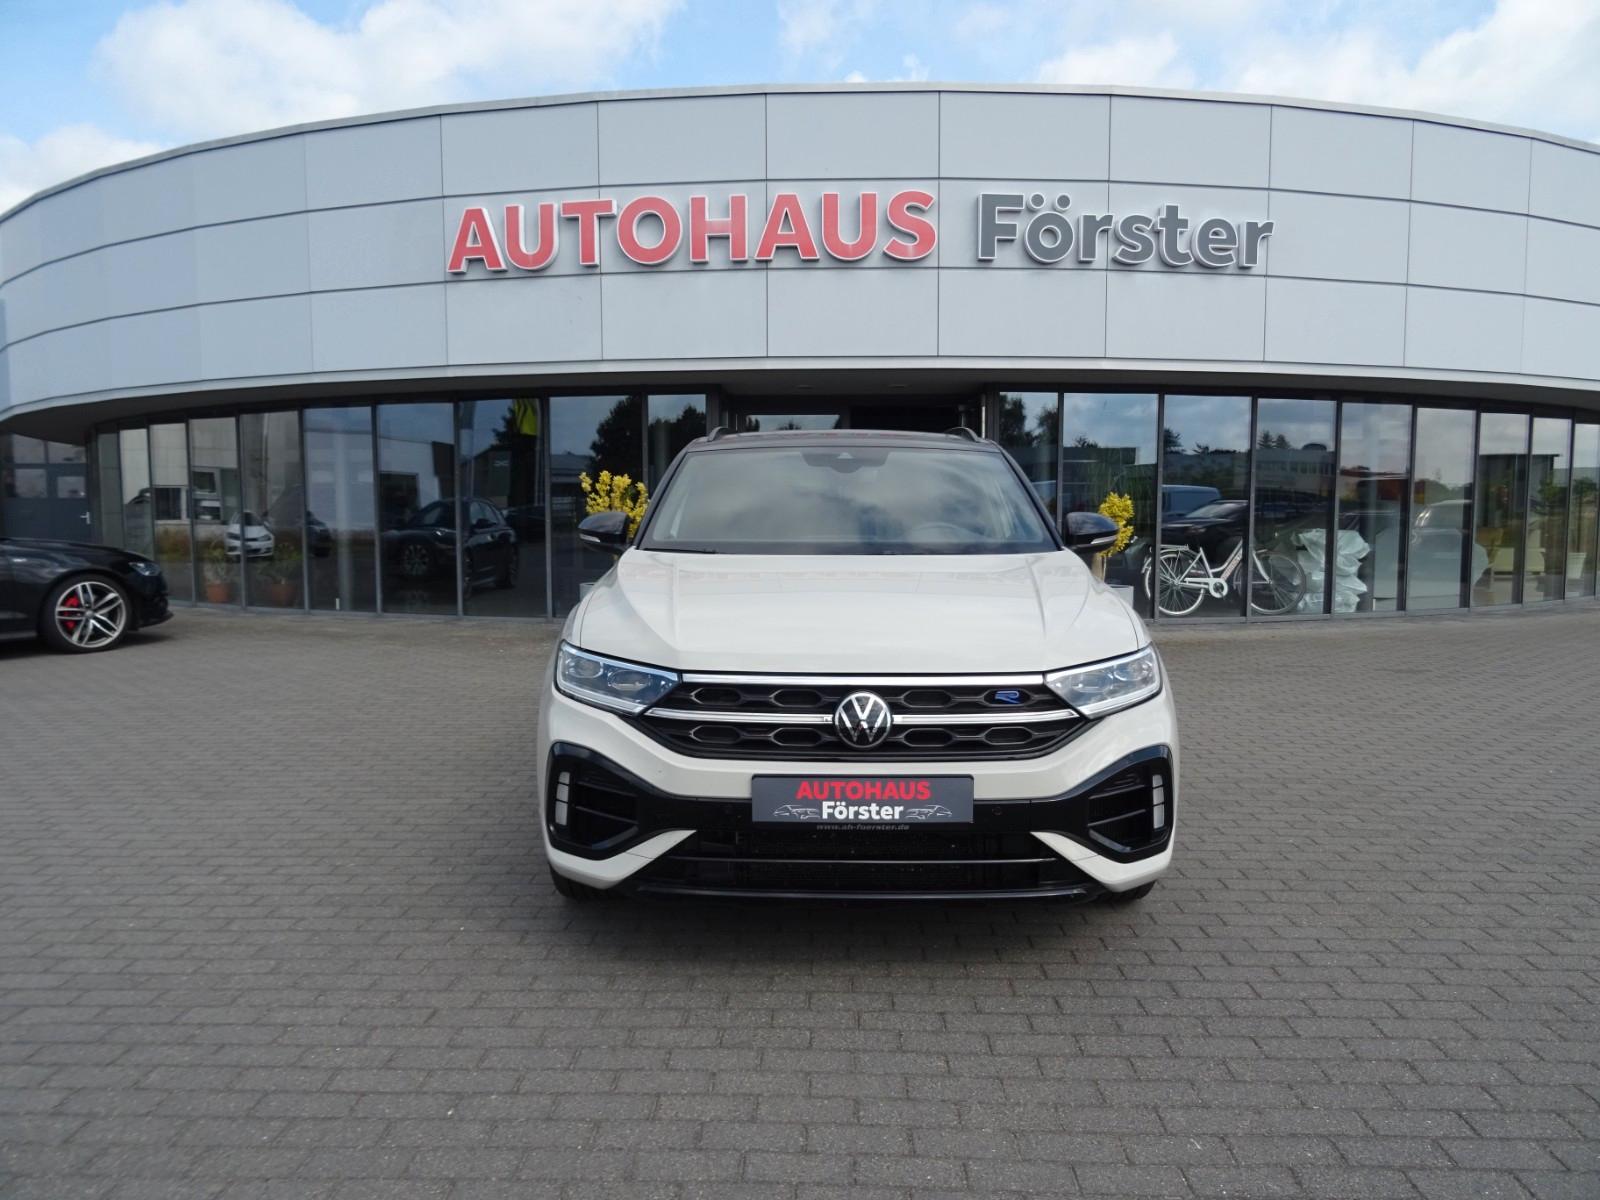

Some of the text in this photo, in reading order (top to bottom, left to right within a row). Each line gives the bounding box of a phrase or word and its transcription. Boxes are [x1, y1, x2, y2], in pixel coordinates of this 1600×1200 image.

[447, 190, 1275, 274] AUTOHAUS Förster
[994, 690, 1021, 705] R
[796, 780, 931, 801] AUTOHAUS
[822, 801, 904, 820] Förster
